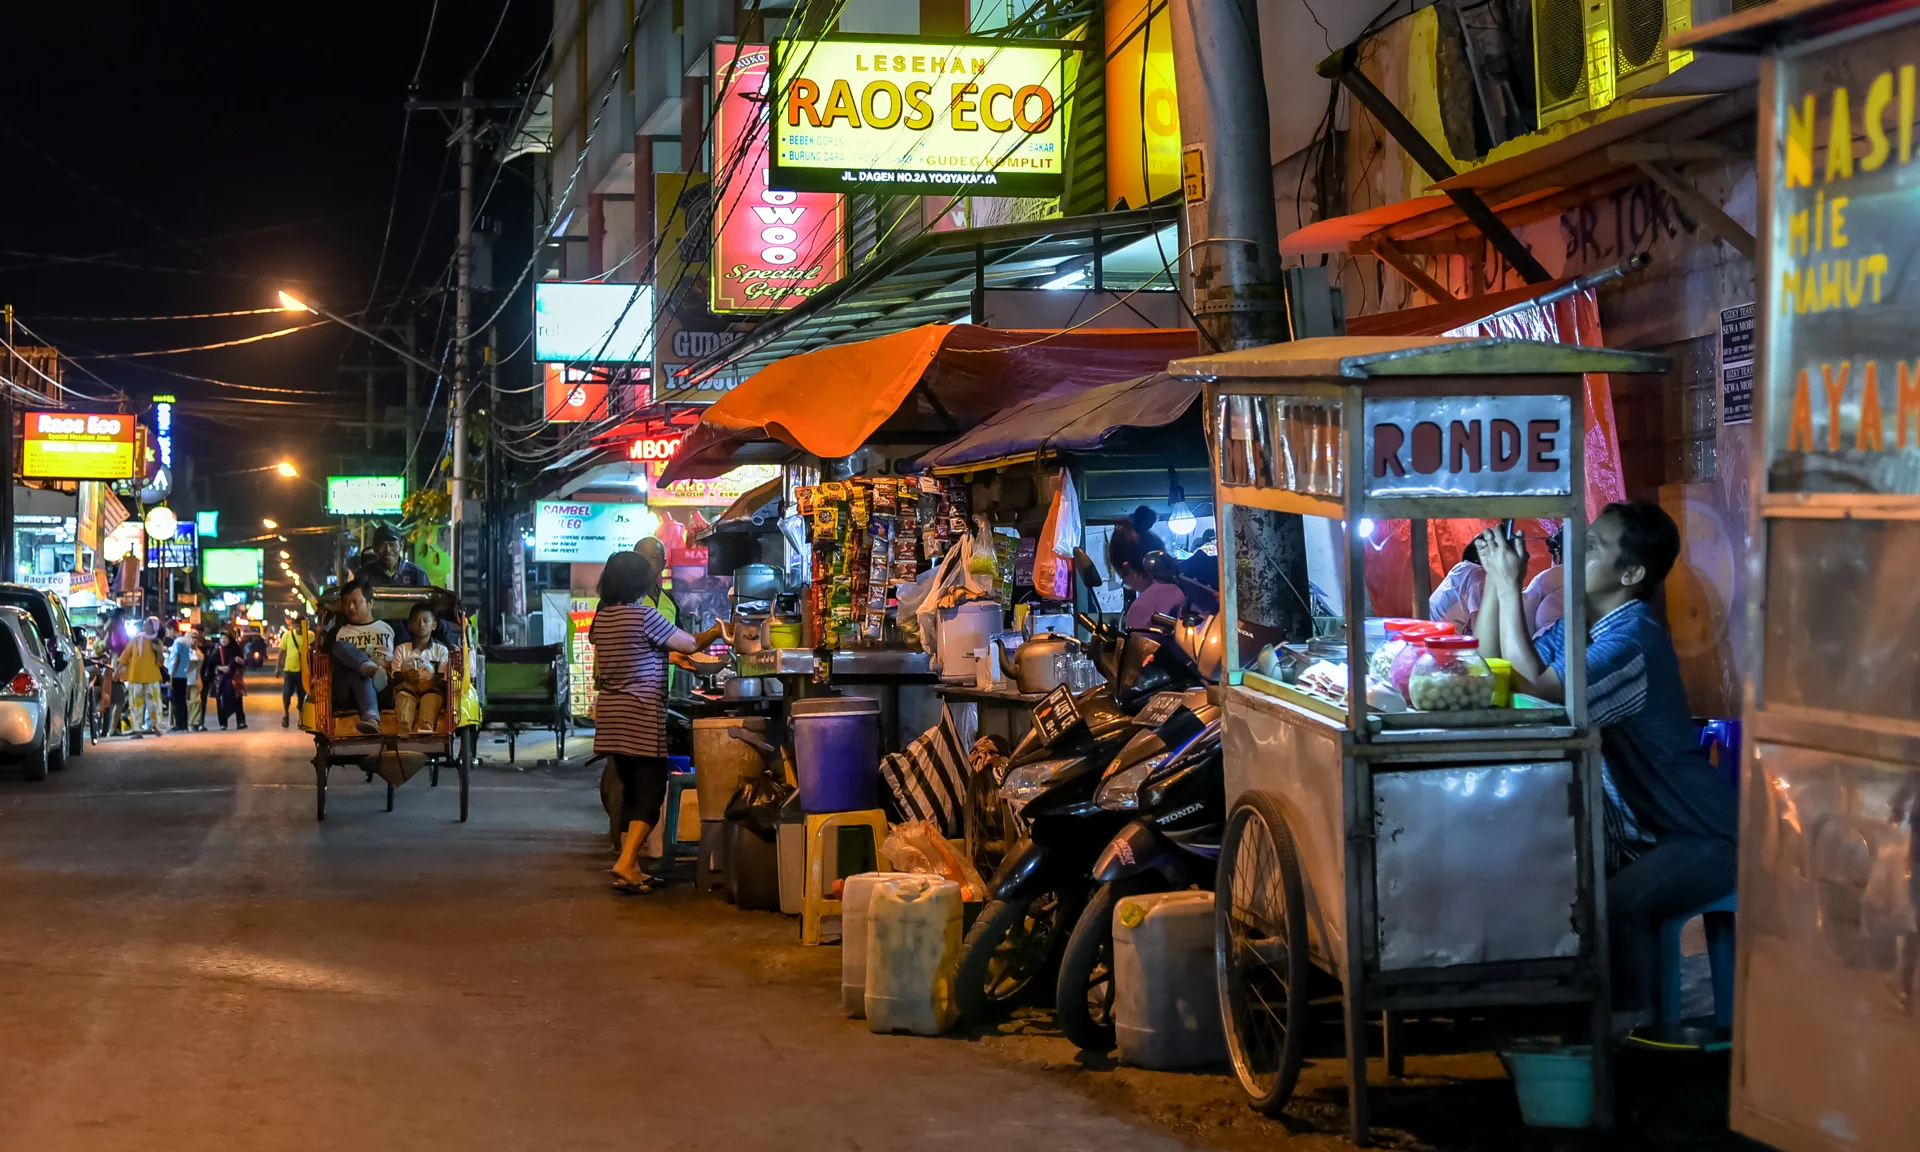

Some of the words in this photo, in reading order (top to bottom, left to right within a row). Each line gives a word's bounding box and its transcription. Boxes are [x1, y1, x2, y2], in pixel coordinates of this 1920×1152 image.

[856, 54, 985, 74] LESEHAN
[787, 77, 934, 131] RAOS
[951, 82, 1054, 134] ECO
[1785, 64, 1916, 189] NASI
[841, 171, 857, 181] JL.
[859, 172, 895, 182] DAGEN
[896, 173, 928, 183] NO.2A
[926, 155, 981, 167] GUDEG
[1789, 190, 1849, 257] MIE
[723, 264, 823, 283] Special
[1781, 254, 1888, 316] MAWUT
[1788, 358, 1920, 452] AYAM
[1373, 418, 1561, 478] RONDE
[23, 576, 46, 585] Raos
[48, 577, 64, 585] Eco
[1159, 803, 1205, 825] HONDA
